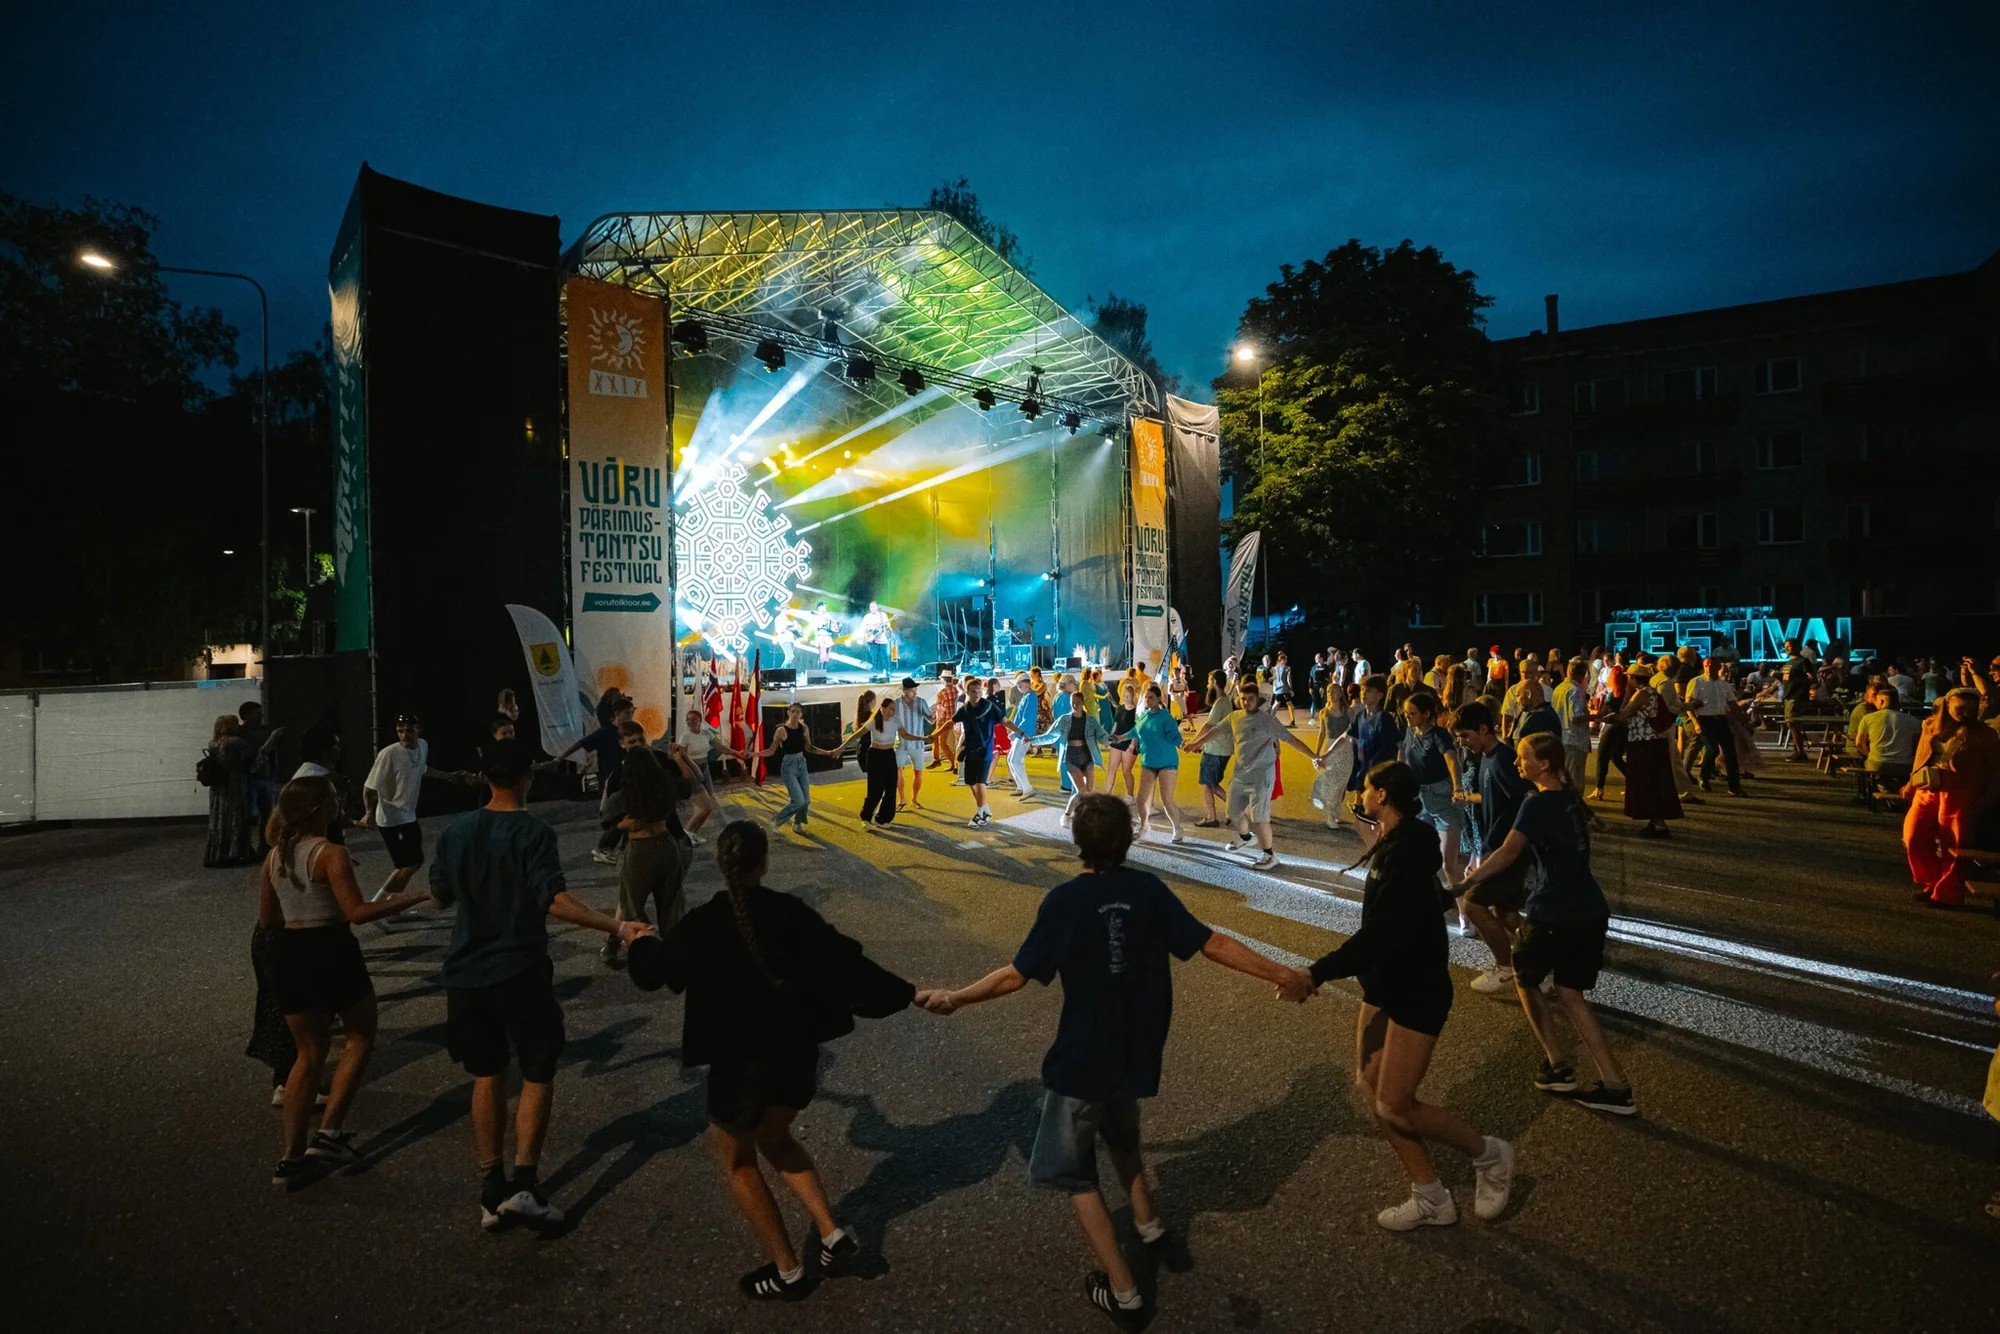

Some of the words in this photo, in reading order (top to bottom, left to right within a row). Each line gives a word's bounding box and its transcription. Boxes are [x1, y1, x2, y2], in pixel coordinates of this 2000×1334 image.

[594, 372, 641, 396] XXIX
[578, 457, 661, 508] VÕRU
[579, 505, 661, 533] PÄRIMUS-
[579, 532, 662, 561] TANTSU
[1135, 523, 1164, 553] VÕRU
[580, 561, 662, 584] FESTIVAL
[1136, 568, 1165, 586] TANTSU
[1604, 617, 1877, 662] FESTIVAL
